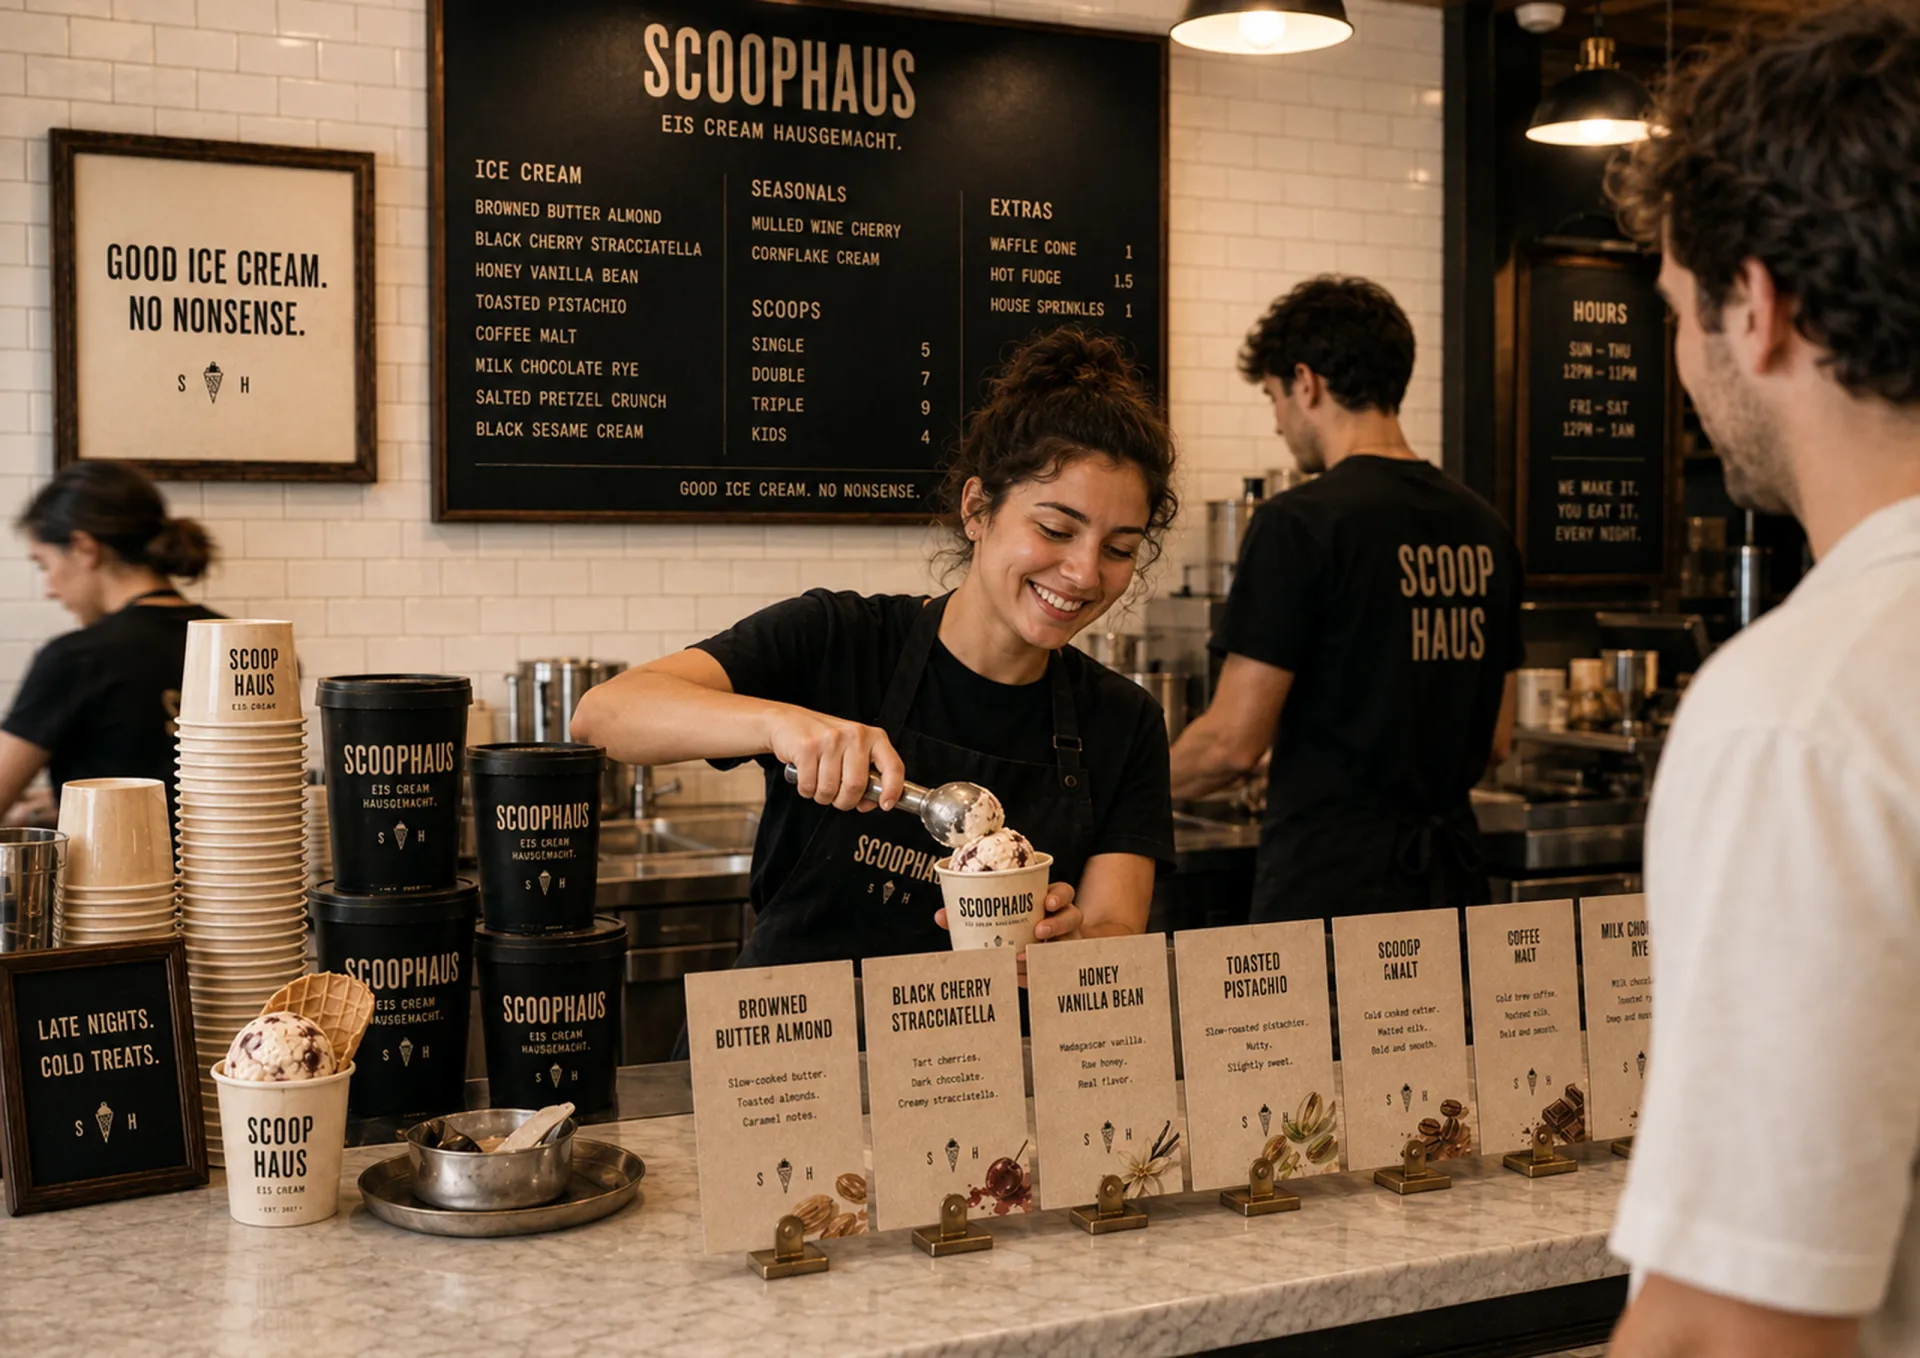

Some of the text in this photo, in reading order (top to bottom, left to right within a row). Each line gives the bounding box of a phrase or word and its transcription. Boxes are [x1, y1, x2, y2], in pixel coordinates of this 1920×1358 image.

[643, 23, 916, 119] SCOOPHAUS
[662, 114, 902, 150] EIS CREAM HAUSGEMACHT.
[476, 159, 581, 184] ICE CREAM
[751, 179, 846, 203] SEASONALS
[475, 199, 661, 224] BROWNED BUTTER ALMOND
[991, 198, 1053, 220] EXTRAS
[752, 216, 901, 238] MULLED WINE CHERRY
[475, 231, 702, 256] BLACK CHERRY STRACCIATELLA
[990, 237, 1132, 259] WAFFLE CONE 1
[107, 243, 327, 288] GOOD ICE CREAM.
[752, 245, 880, 266] CORNFLAKE CREAM
[476, 262, 638, 284] HONEY VANILLA BEAN
[991, 267, 1133, 289] HOT FUDGE 1.5
[476, 294, 626, 314] TOASTED PISTACHIO
[752, 299, 820, 319] SCOOPS
[991, 297, 1132, 318] HOUSE SPRINKLES 1
[1573, 301, 1627, 324] HOURS
[130, 295, 305, 336] NO NONSENSE.
[476, 325, 577, 344] COFFEE MALT
[752, 336, 930, 357] SINGLE 5
[1569, 341, 1631, 359] SUN THU
[476, 358, 639, 377] MILK CHOCOLATE RYE
[752, 366, 930, 386] DOUBLE 7
[1564, 363, 1637, 380] 12PM 11PM
[178, 374, 249, 394] S H
[476, 389, 666, 408] SALTED PRETZEL CRUNCH
[752, 396, 930, 415] TRIPLE 9
[1570, 399, 1629, 415] FRI SAT
[476, 421, 643, 439] BLACK SESAME CREAM
[752, 427, 930, 444] KIDS 4
[1563, 421, 1635, 437] 12PM 1AM
[680, 481, 920, 498] GOOD ICE CREAM. NO NONSENSE.
[1558, 480, 1638, 496] WE MAKE IT.
[1557, 503, 1638, 520] YOU EAT IT.
[1556, 526, 1640, 542] EVERY NIGHT.
[1398, 544, 1494, 597] SCOOP
[1412, 607, 1485, 661] HAUS
[230, 648, 279, 670] SCOOP
[235, 673, 275, 696] HAUS
[344, 742, 453, 775] SCOOPHAUS
[372, 784, 429, 795] EIS CREAM
[496, 802, 589, 831] SCOOPHAUS
[378, 830, 425, 844] S H
[520, 838, 537, 848] EIS
[854, 835, 941, 884] SCOOPHA
[525, 878, 565, 890] S H
[959, 892, 1033, 918] SCOOPHAUS
[1507, 928, 1540, 946] COFFEE
[1601, 922, 1624, 939] MILK
[1514, 947, 1536, 964] MALT
[1631, 940, 1648, 957] RYE
[345, 951, 459, 990] SCOOPHAUS
[1226, 952, 1280, 975] TOASTED
[1079, 965, 1118, 987] HONEY
[892, 978, 991, 1006] BLACK CHERRY
[1224, 975, 1287, 999] PISTACHIO
[376, 997, 435, 1010] EIS CREAM
[503, 991, 605, 1024] SCOOPHAUS
[738, 994, 807, 1019] BROWNED
[1057, 987, 1144, 1013] VANILLA BEAN
[38, 1008, 154, 1040] LATE NIGHTS.
[892, 1004, 996, 1032] STRACCIATELLA
[529, 1032, 546, 1042] EIS
[716, 1019, 832, 1049] BUTTER ALMOND
[41, 1044, 159, 1078] COLD TREATS.
[382, 1045, 429, 1061] S H
[912, 1054, 981, 1068] Tart cherries.
[1100, 1058, 1127, 1068] honey.
[535, 1070, 578, 1083] S H
[728, 1071, 827, 1088] Slow-cooked butter.
[911, 1072, 984, 1087] Dark chocolate.
[737, 1095, 775, 1107] Toasted
[75, 1113, 137, 1137] S H
[248, 1115, 313, 1145] SCOOP
[743, 1112, 817, 1127] Caramel notes.
[254, 1149, 307, 1178] HAUS
[257, 1186, 272, 1195] EIS
